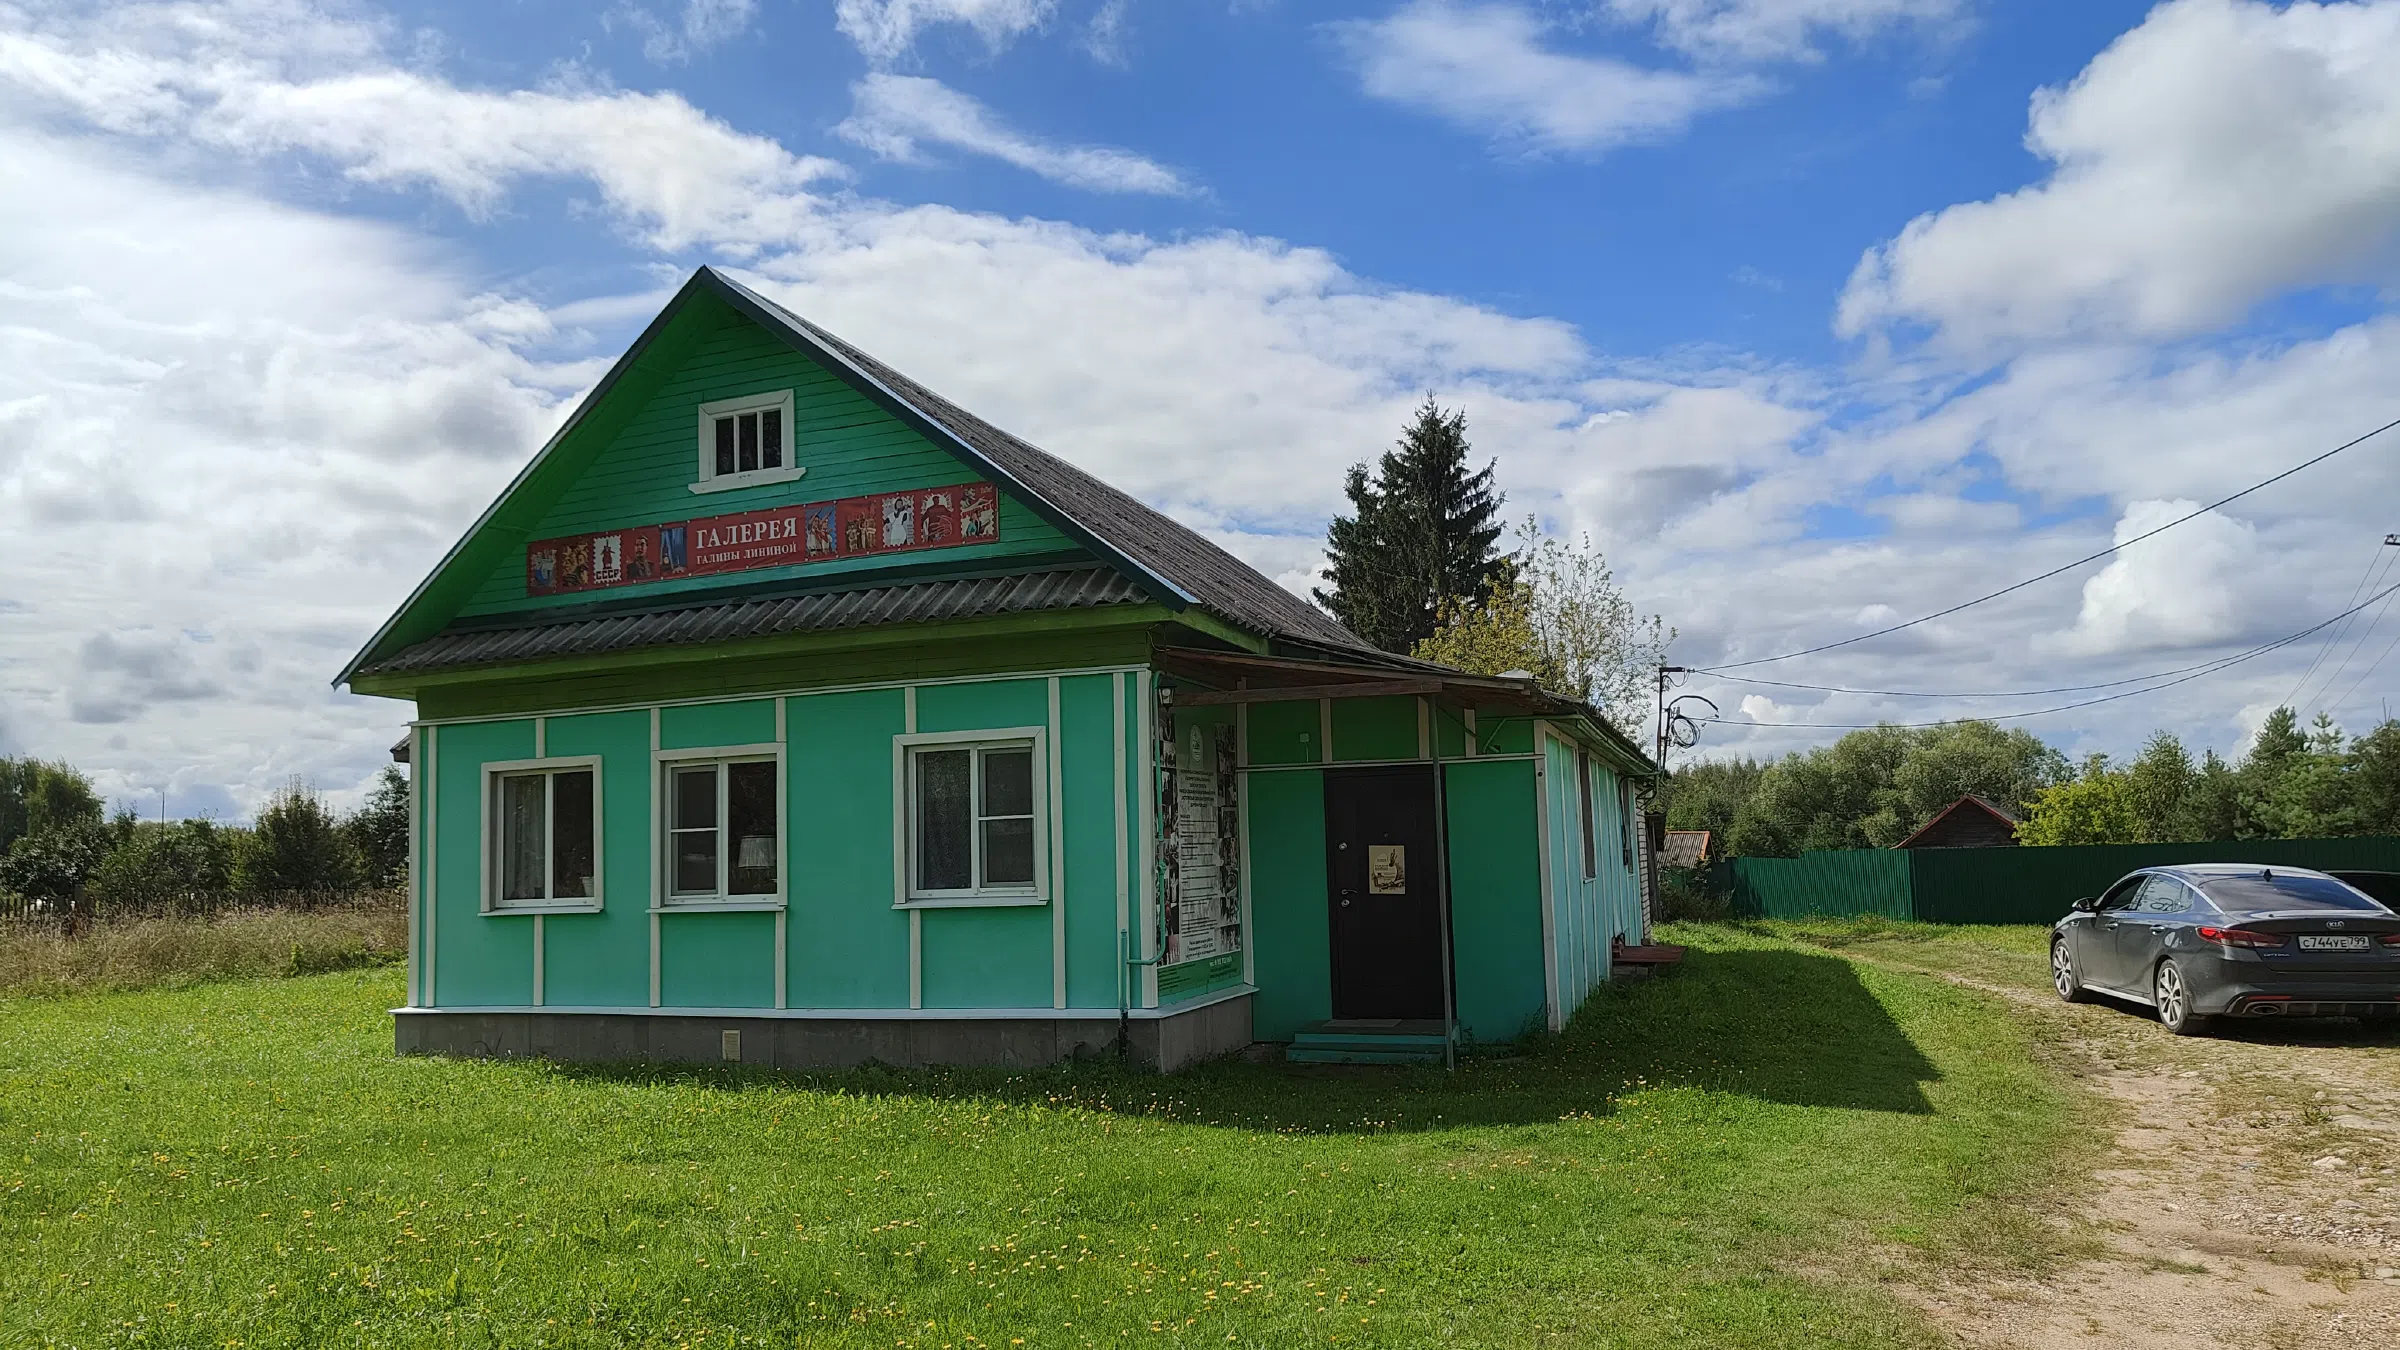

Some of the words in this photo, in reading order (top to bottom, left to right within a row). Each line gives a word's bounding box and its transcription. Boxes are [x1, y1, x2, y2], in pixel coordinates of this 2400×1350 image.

[696, 517, 797, 549] ГАЛЕРЕЯ
[696, 550, 740, 565] ГАЛИНЫ
[743, 541, 797, 559] ЛИНИНОЙ
[595, 568, 620, 580] СССР
[2348, 936, 2366, 946] 799
